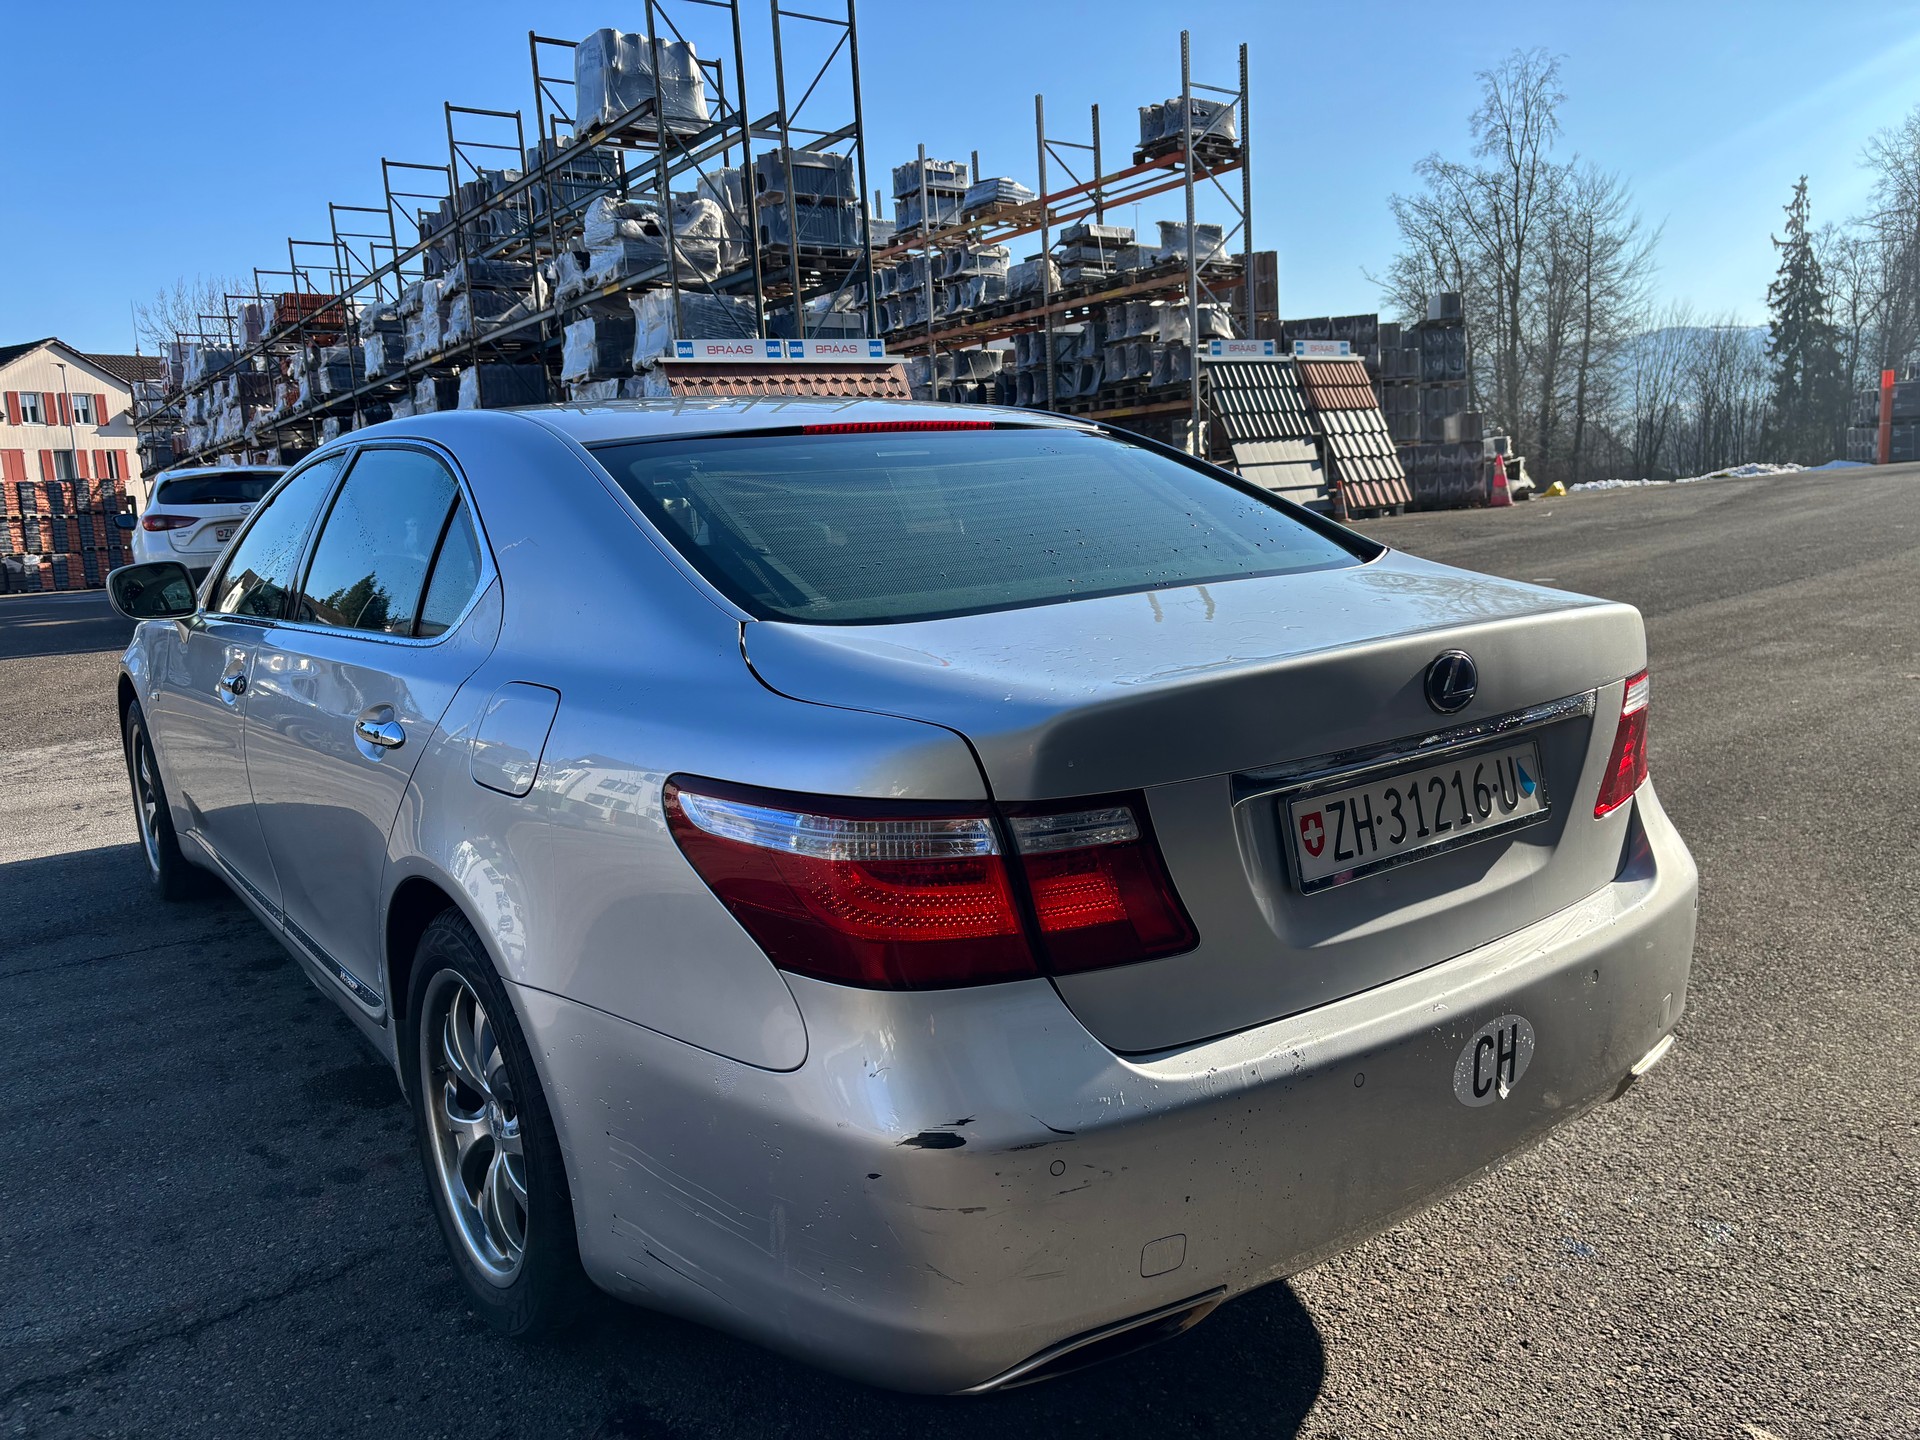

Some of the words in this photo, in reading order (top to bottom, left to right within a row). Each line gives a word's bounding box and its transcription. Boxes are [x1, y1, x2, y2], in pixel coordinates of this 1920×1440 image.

[678, 346, 693, 354] BMI
[706, 345, 754, 355] BRAAS
[767, 345, 780, 353] BMI
[815, 345, 858, 354] BRAAS
[869, 345, 881, 353] BMI
[1228, 344, 1257, 352] BRAAS
[1472, 1023, 1518, 1098] CH
